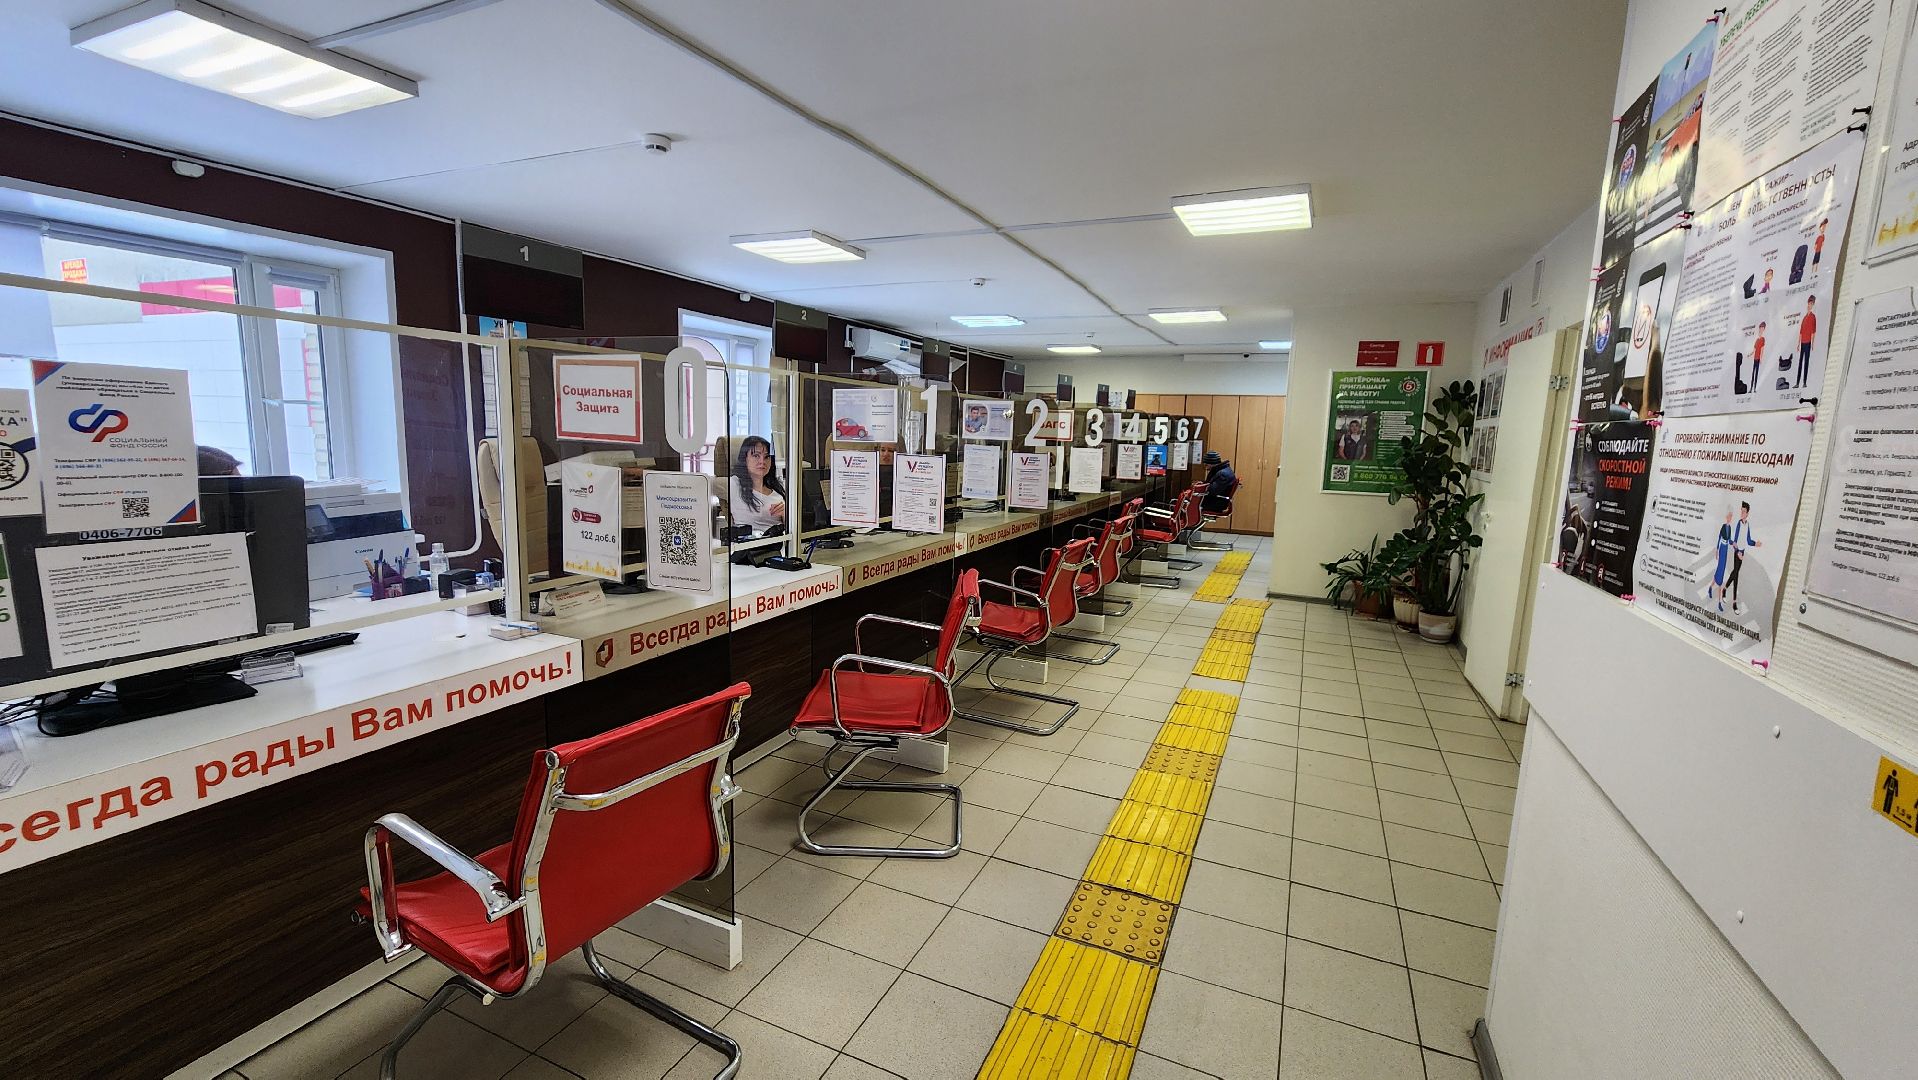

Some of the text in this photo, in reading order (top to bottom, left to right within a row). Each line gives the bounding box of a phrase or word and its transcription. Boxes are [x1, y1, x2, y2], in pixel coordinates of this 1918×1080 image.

[519, 245, 529, 262] 1
[801, 309, 808, 321] 2
[934, 344, 940, 352] 3
[562, 384, 633, 399] Социальная
[664, 346, 708, 454] 0
[575, 401, 620, 414] Защита
[920, 384, 938, 450] 1
[1024, 399, 1049, 446] 2
[1085, 408, 1104, 447] 3
[1125, 413, 1142, 444] 4
[1153, 416, 1169, 444] 5
[1176, 418, 1189, 442] 6
[1193, 418, 1204, 439] 7
[109, 436, 168, 444] СОЦИАЛЬНЫЙ
[1598, 437, 1650, 456] СОБЛЮДАЙТЕ
[1675, 432, 1766, 445] ПРОЯВЛЯЙТЕ ВНИМАНИЕ ПО
[1599, 457, 1646, 475] СКОРОСТНОЙ
[1659, 447, 1693, 460] ОТНОШЕНИЮ
[1698, 449, 1734, 462] ПОЖИЛЫМ
[1734, 450, 1795, 468] ПЕШЕХОДАМ
[1605, 475, 1633, 491] РЕЖИМ!
[80, 527, 162, 540] 0406-7706
[581, 530, 593, 541] 122
[977, 530, 997, 545] Всегда
[862, 539, 966, 581] Всегда рады Вам помочь!
[630, 574, 840, 656] Всегда рады Вам помочь!
[194, 726, 337, 801] рады
[351, 698, 434, 742] Вам
[445, 651, 574, 714] помочь!
